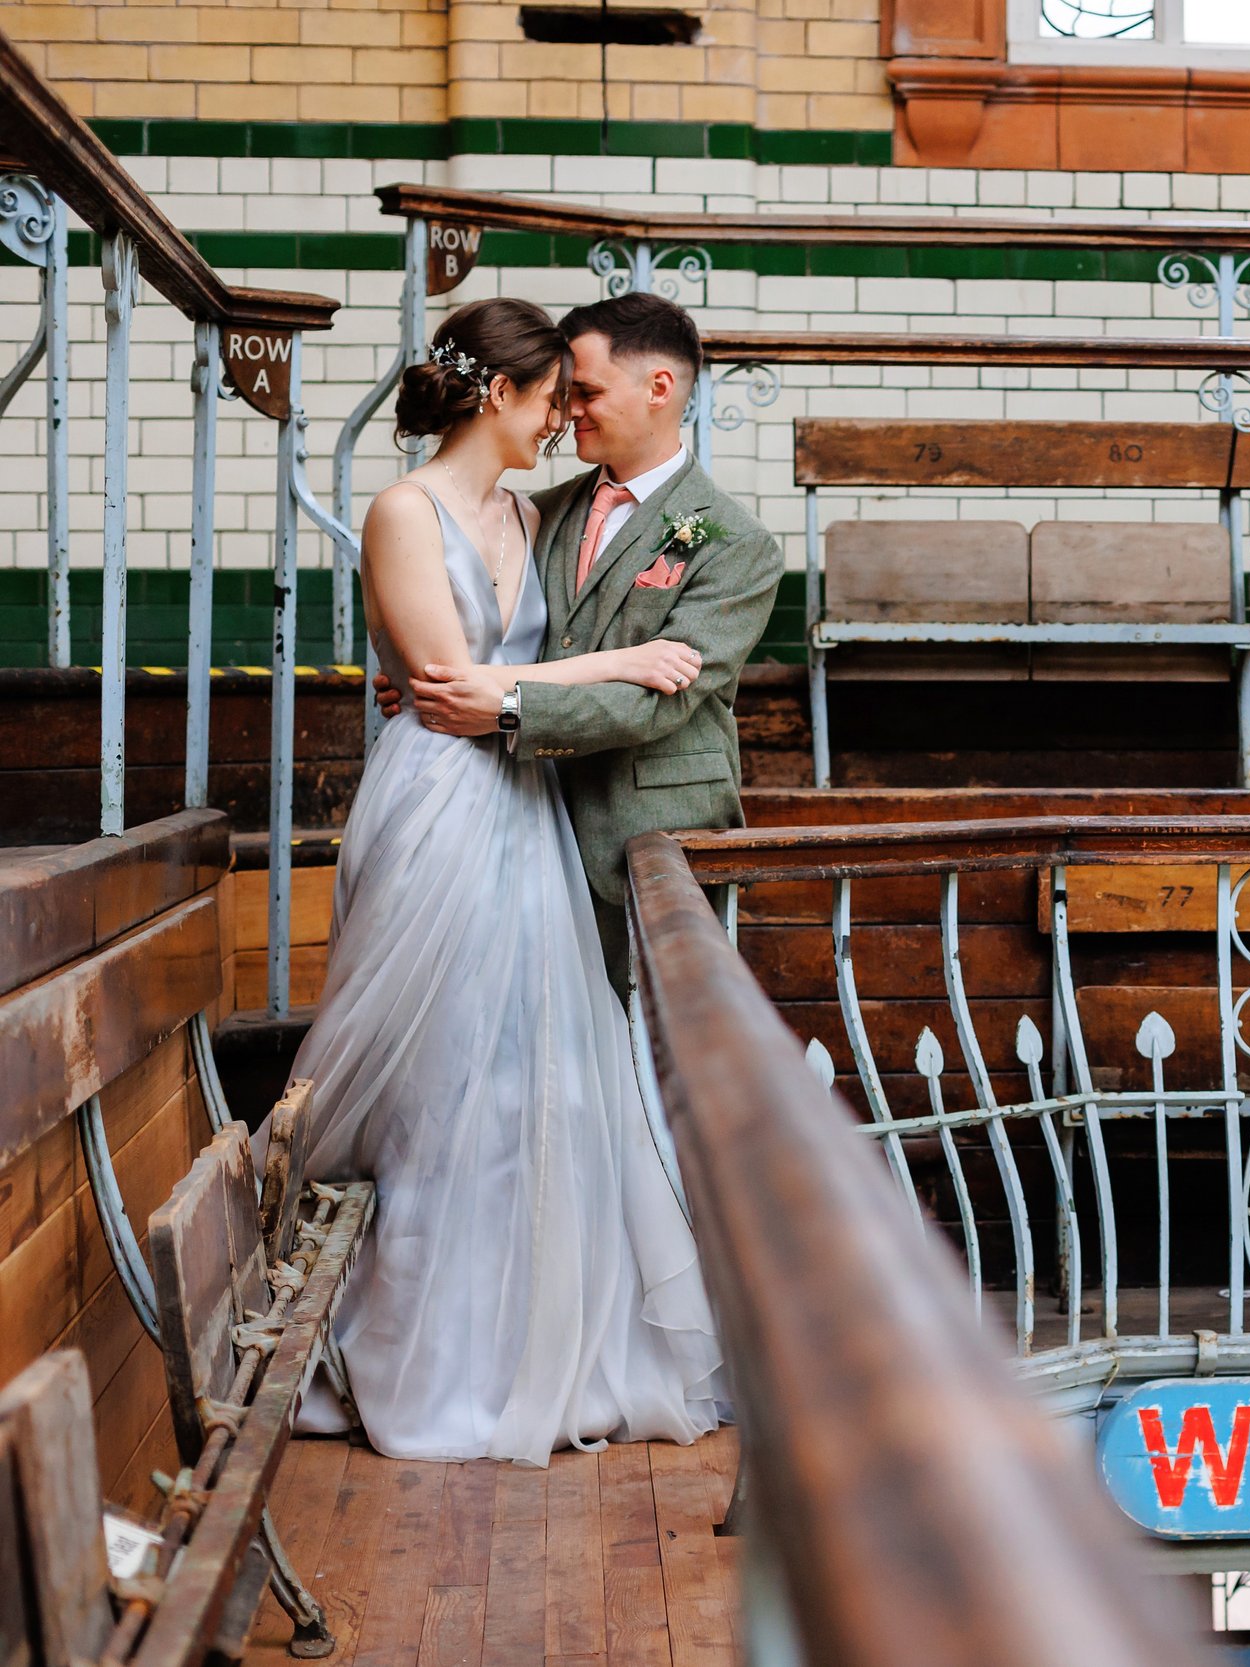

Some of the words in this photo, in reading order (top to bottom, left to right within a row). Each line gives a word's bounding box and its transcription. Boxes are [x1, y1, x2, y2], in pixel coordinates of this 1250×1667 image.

[430, 225, 481, 251] ROW
[445, 254, 458, 277] B
[228, 333, 292, 364] ROW
[252, 368, 271, 394] A
[914, 442, 943, 463] 79
[1109, 444, 1143, 463] 80
[1160, 885, 1195, 907] 77
